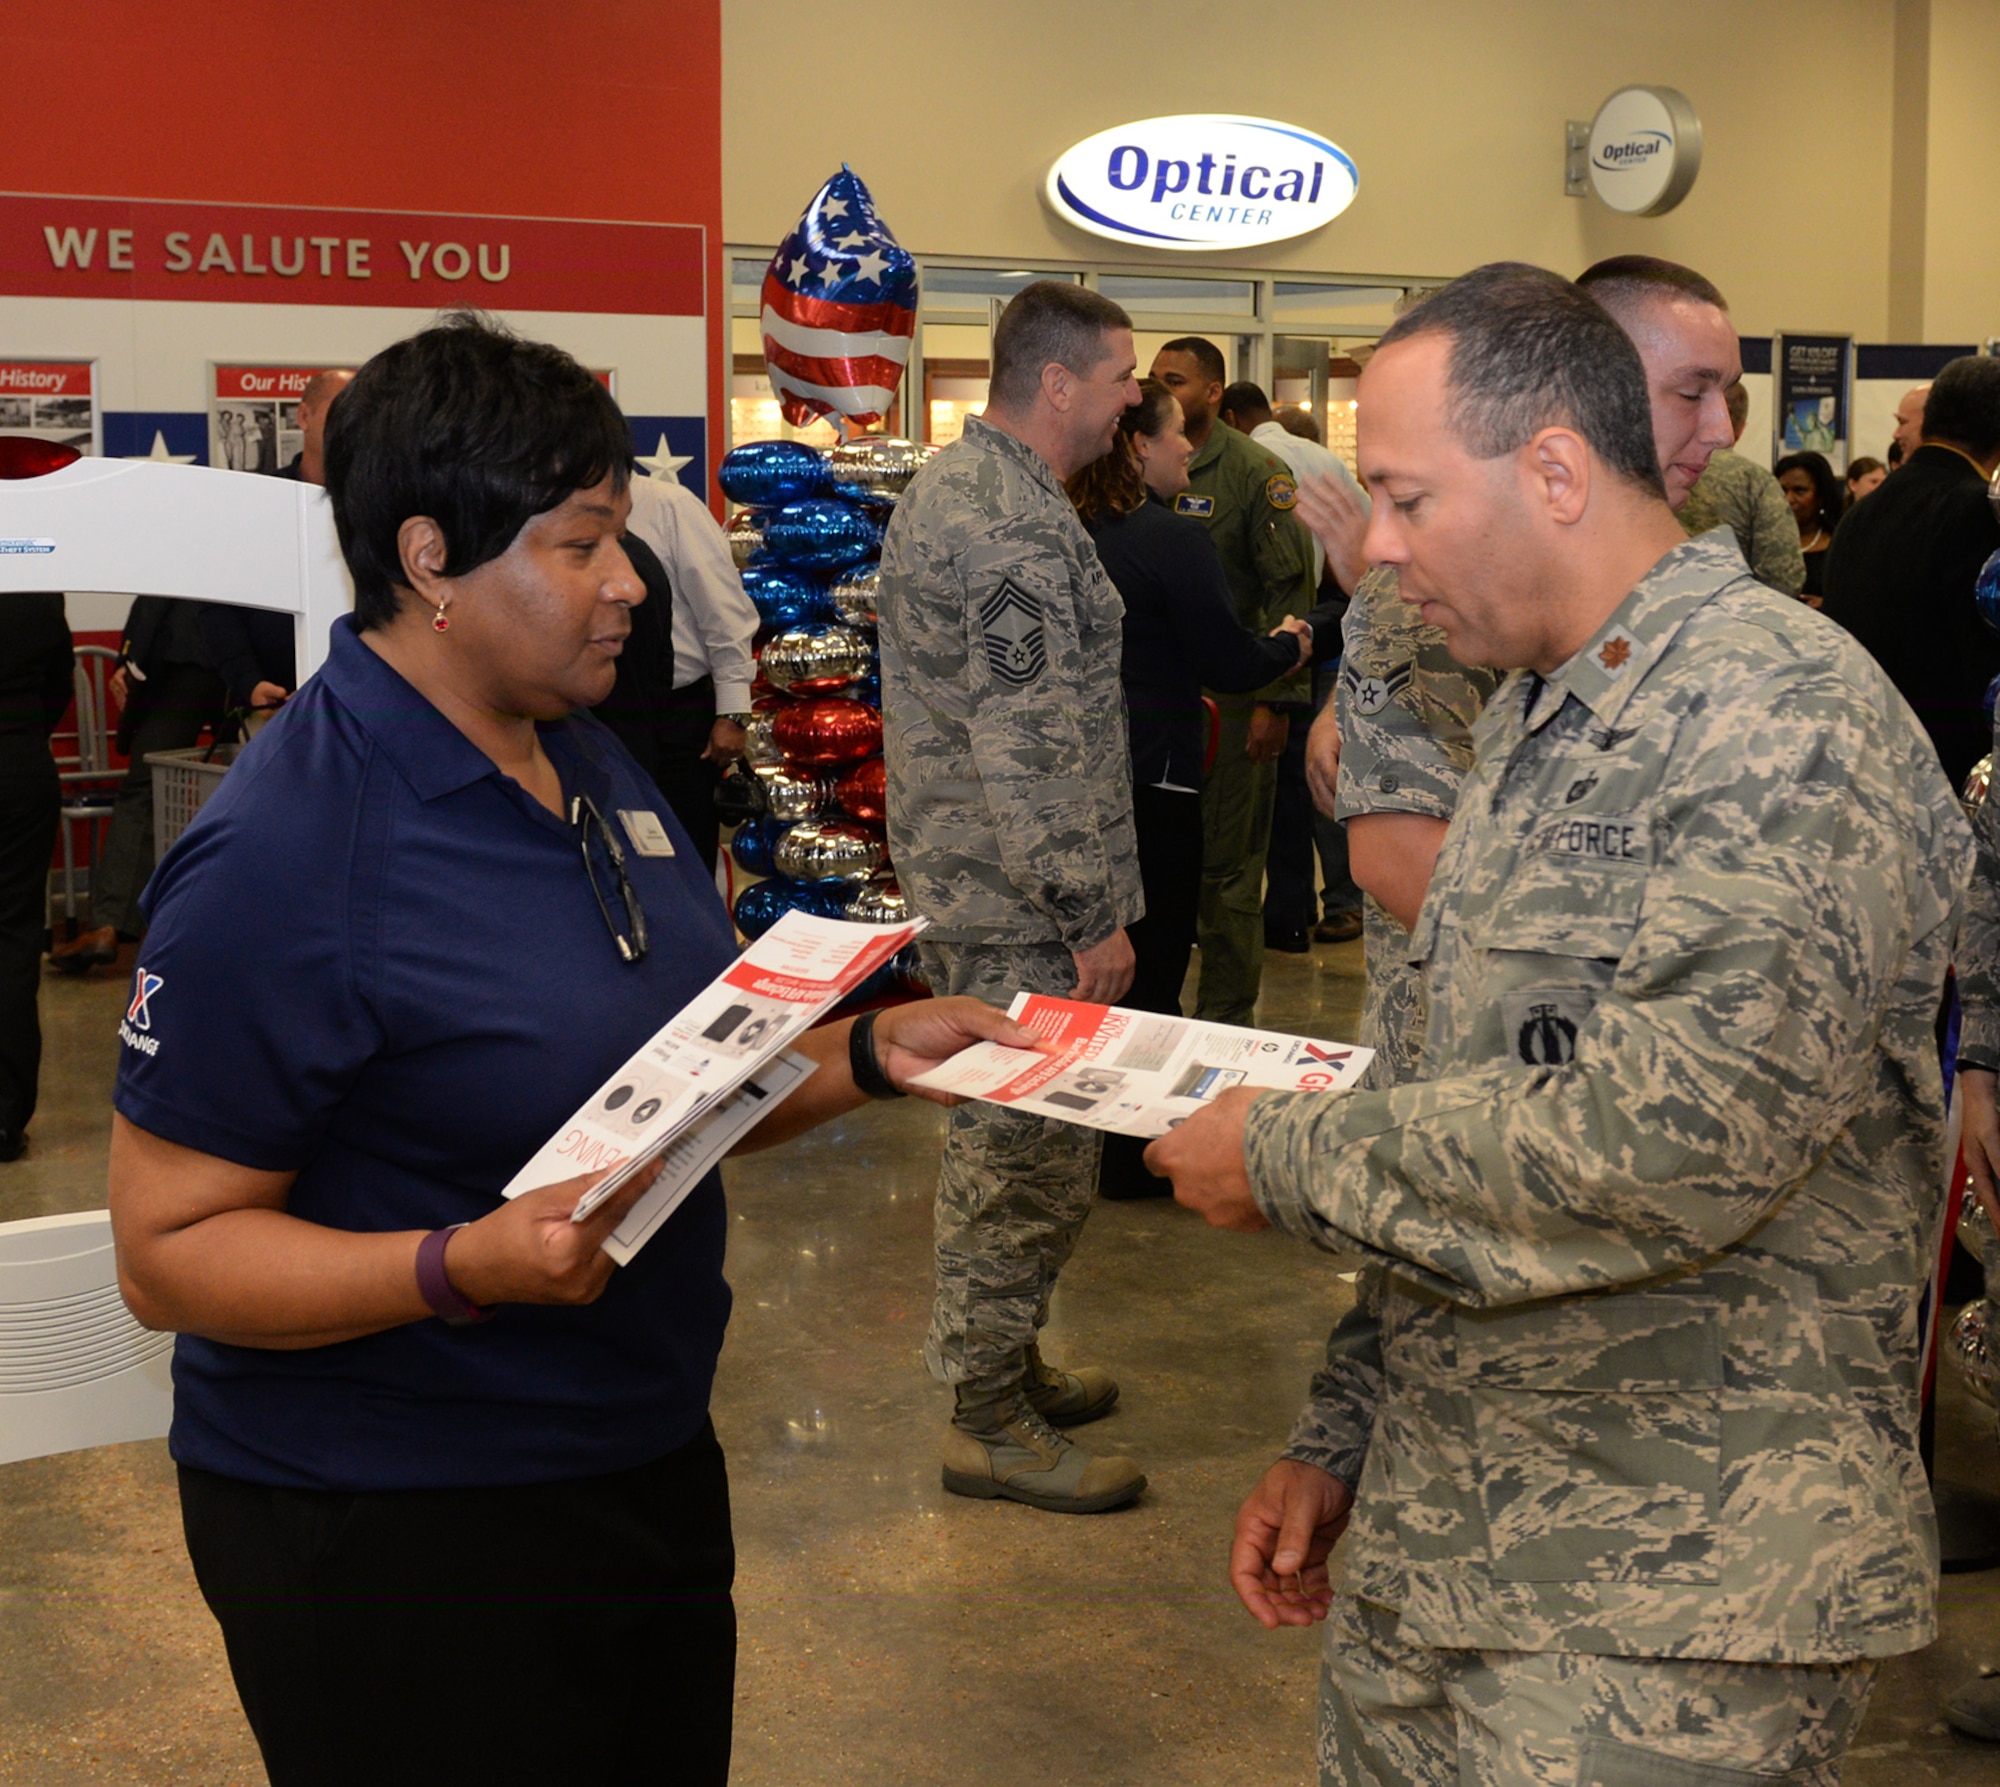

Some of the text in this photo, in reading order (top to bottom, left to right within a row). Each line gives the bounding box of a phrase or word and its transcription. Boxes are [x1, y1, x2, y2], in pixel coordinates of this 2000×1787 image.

[1603, 140, 1661, 161] Optical
[1107, 145, 1324, 203] Optical
[1170, 203, 1273, 225] CENTER
[43, 226, 511, 282] WE SALUTE YOU
[0, 368, 68, 393] History
[240, 372, 276, 391] Our
[556, 1128, 623, 1171] ENING
